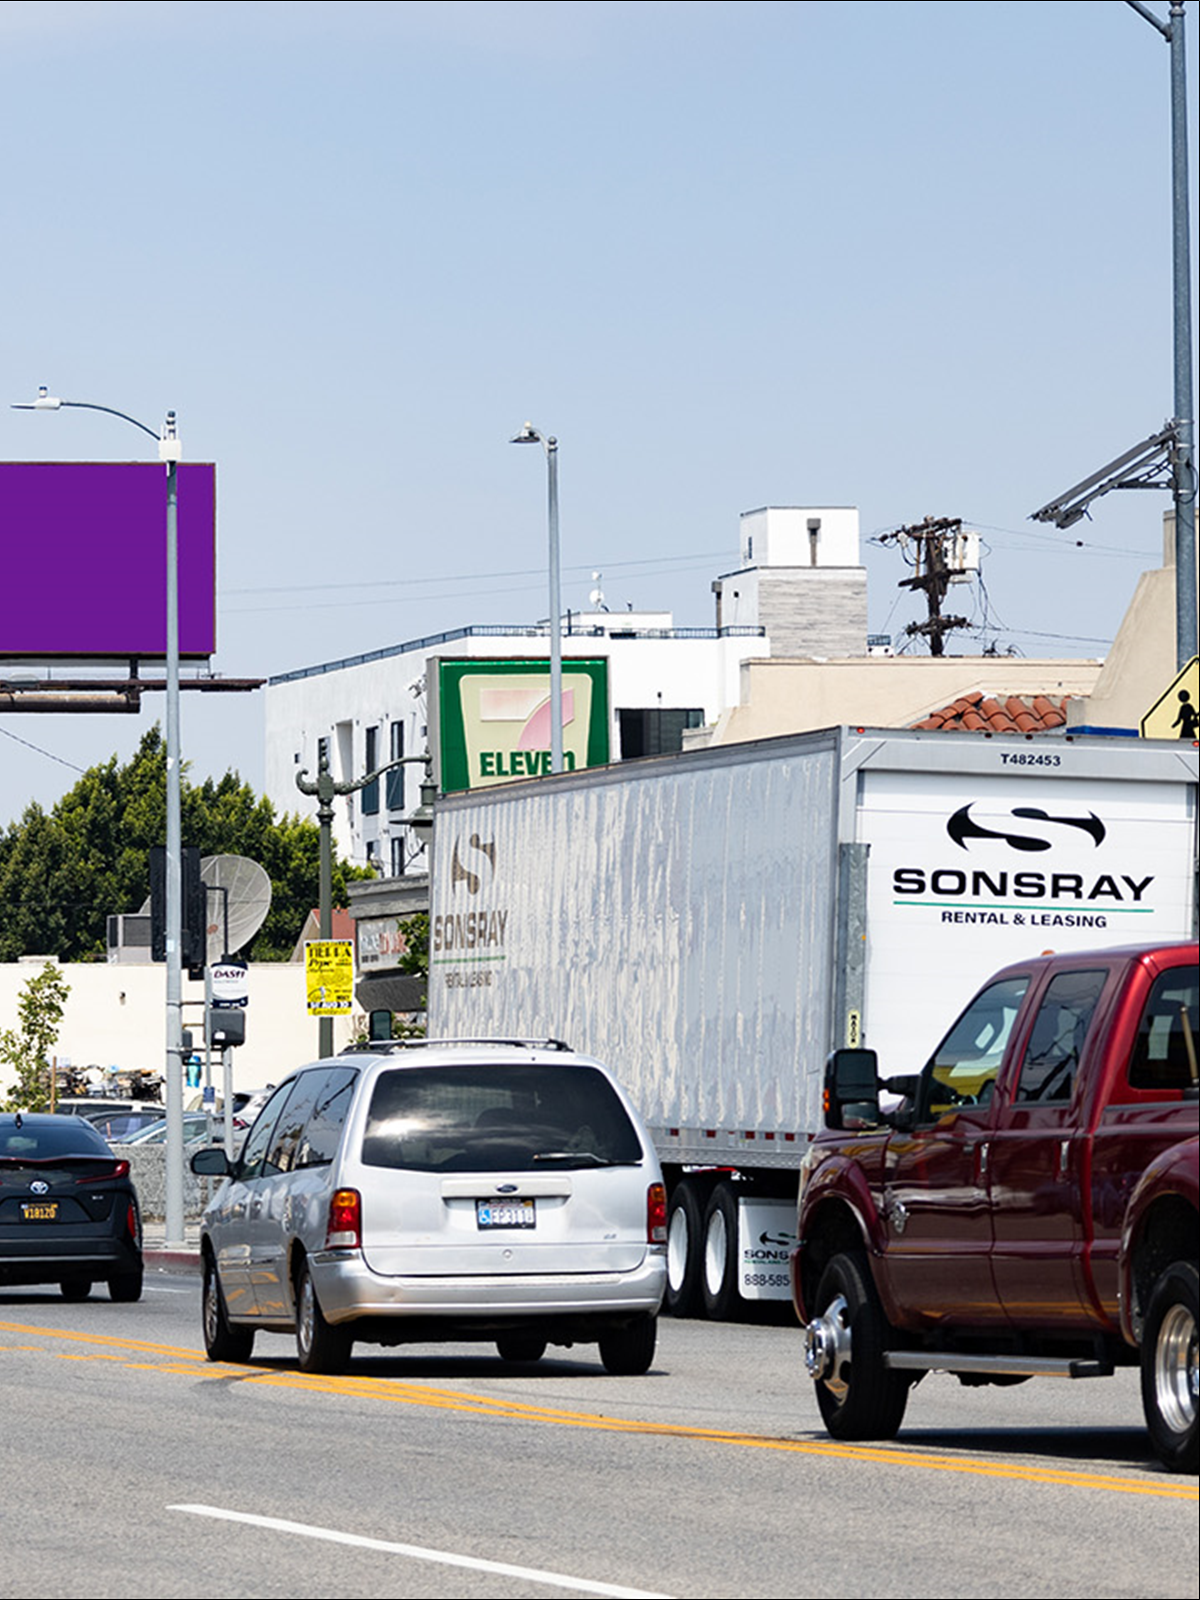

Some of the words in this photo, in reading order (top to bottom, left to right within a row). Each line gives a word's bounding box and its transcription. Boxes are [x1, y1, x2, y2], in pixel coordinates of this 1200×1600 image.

[1000, 753, 1062, 767] T482453
[893, 868, 1155, 901] SONSRAY
[941, 911, 1009, 926] RENTAL
[1013, 912, 1026, 926] &
[1031, 914, 1107, 928] LEASING
[434, 910, 508, 952] SONSRAY
[744, 1249, 789, 1260] SONS
[744, 1273, 791, 1287] 888-585
